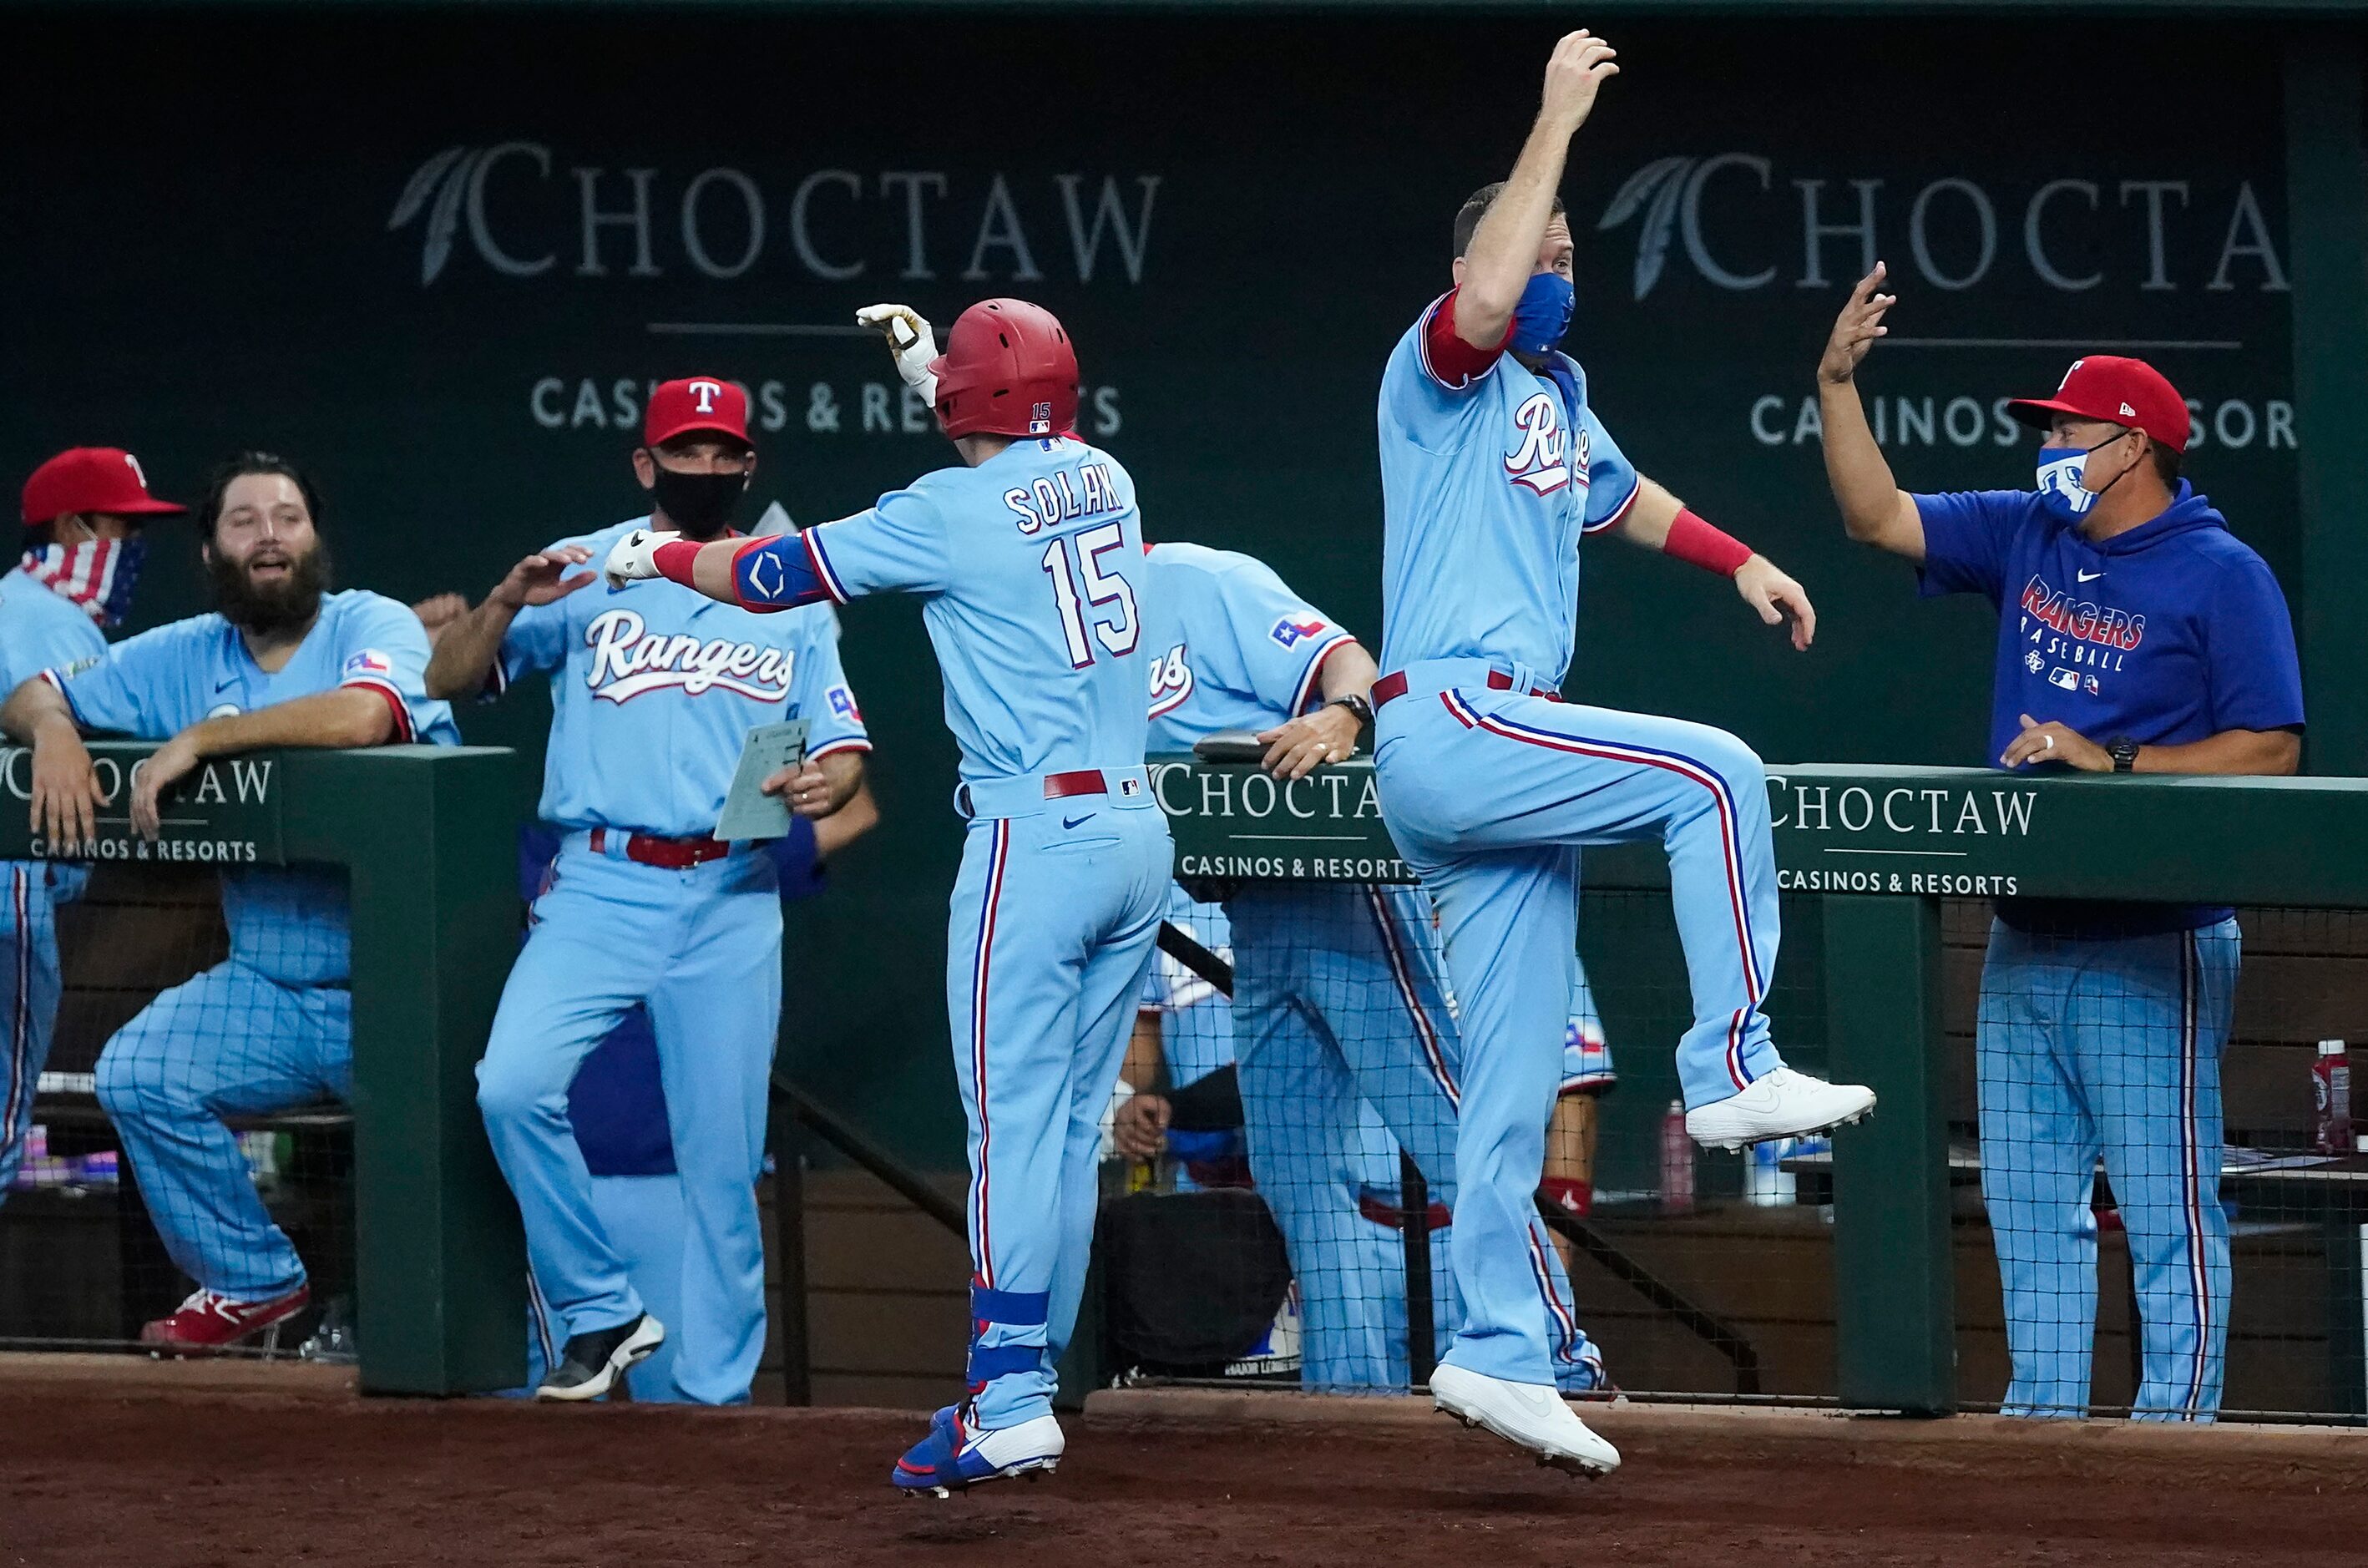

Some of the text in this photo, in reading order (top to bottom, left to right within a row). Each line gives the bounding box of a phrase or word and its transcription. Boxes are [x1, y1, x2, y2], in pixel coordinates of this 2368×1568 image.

[467, 141, 1164, 284] CHOCTAW
[1681, 152, 2291, 290] CHOCTA
[689, 382, 723, 413] T
[807, 382, 840, 432] &
[1032, 402, 1051, 419] 15
[1750, 395, 2021, 447] CAINOS
[1041, 520, 1141, 670] 15
[584, 608, 795, 704] Rangers
[1156, 763, 1382, 818] CHOCTA
[158, 840, 256, 862] RESORTS
[1181, 855, 1285, 878] CASINOS
[1292, 858, 1305, 878] &
[1776, 869, 2018, 896] CASINOS & RESORTS
